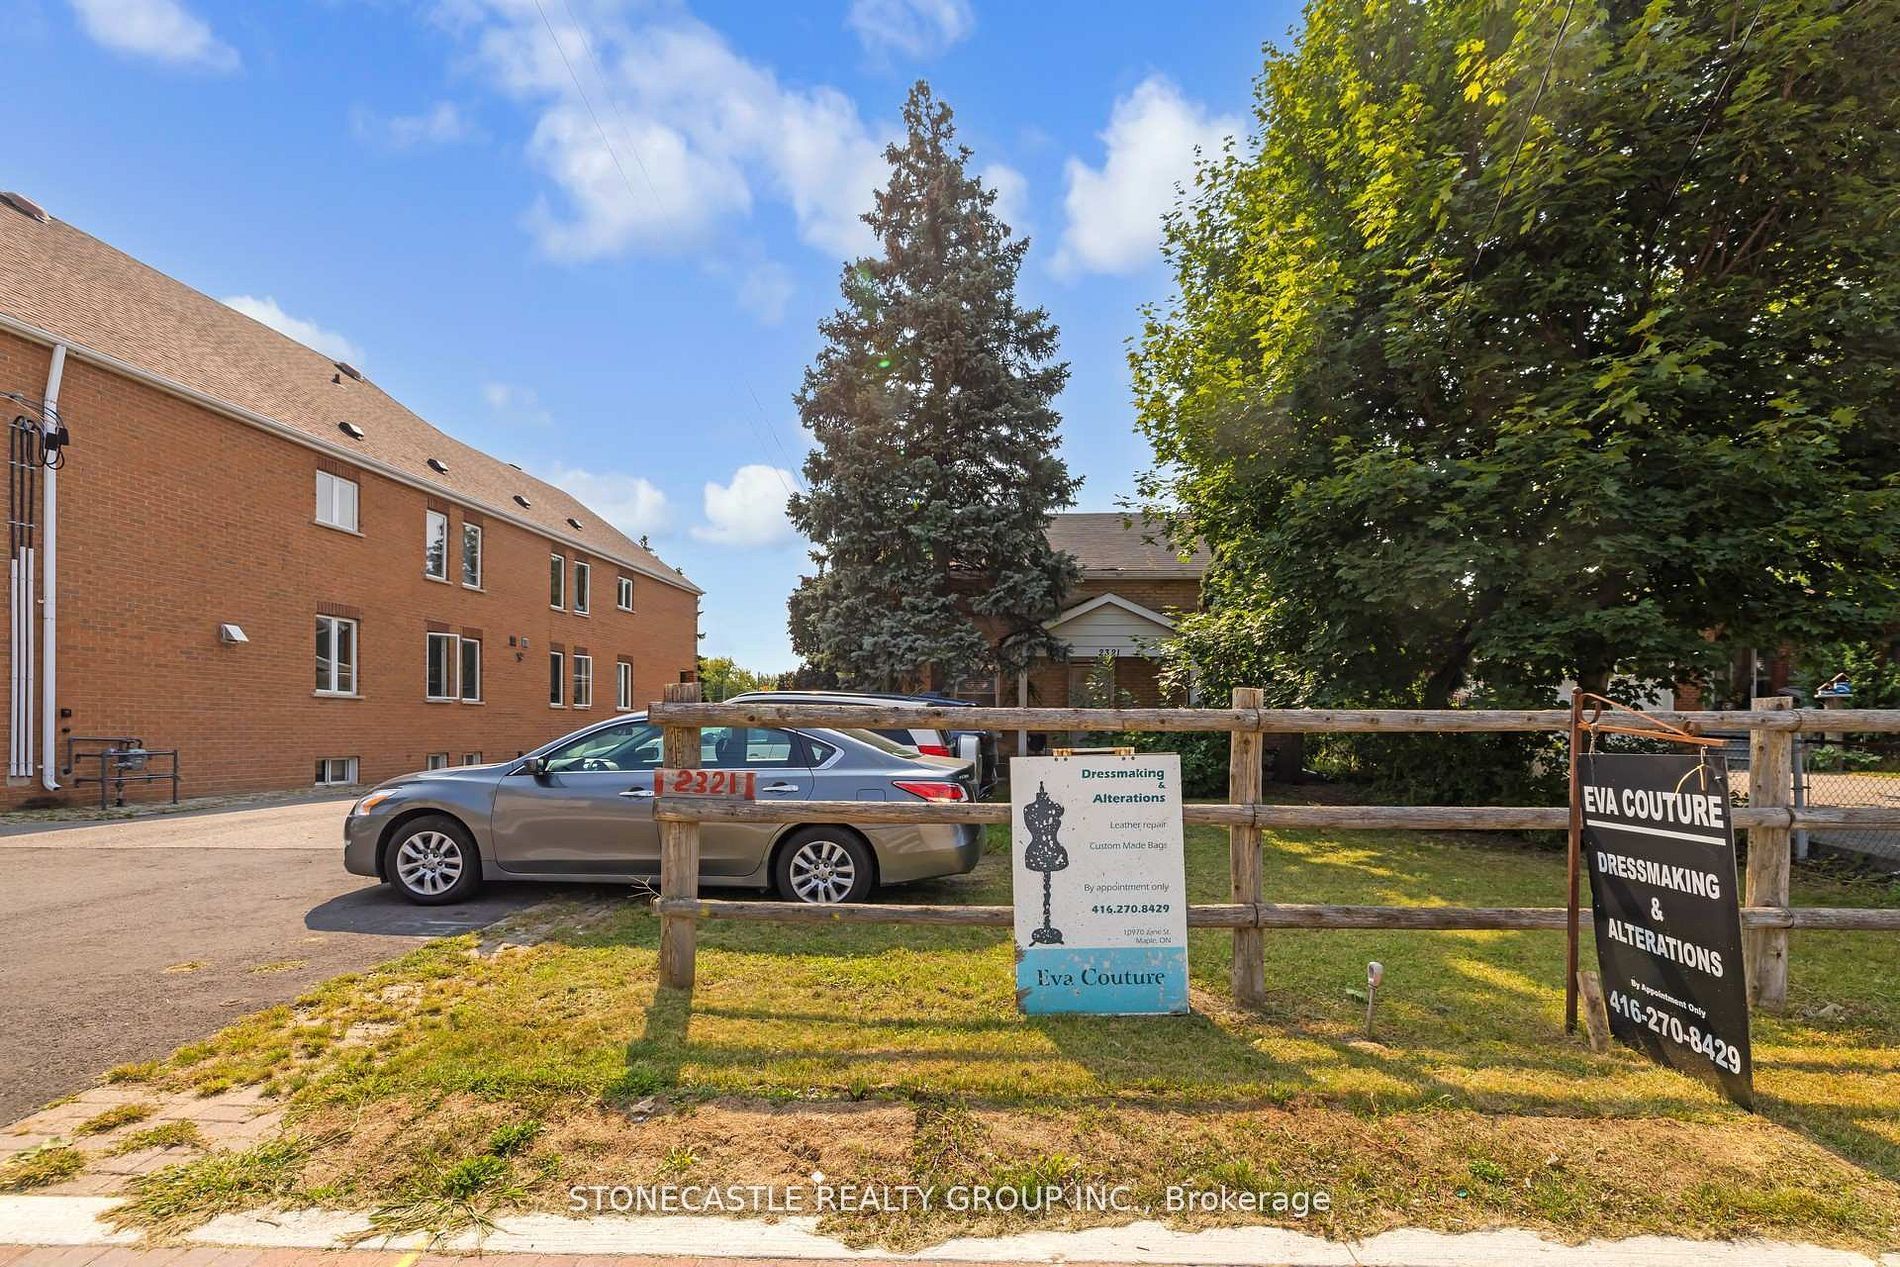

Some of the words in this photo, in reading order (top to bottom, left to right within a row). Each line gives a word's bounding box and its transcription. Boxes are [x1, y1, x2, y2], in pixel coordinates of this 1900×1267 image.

[1098, 648, 1120, 656] 2321
[673, 770, 736, 794] 2321
[1081, 768, 1165, 780] Dressmaking
[1092, 792, 1166, 804] Alterations
[1583, 785, 1620, 816] EVA
[1622, 788, 1725, 829] COUTURE
[1110, 821, 1141, 830] Leather
[1143, 821, 1167, 831] repair
[1089, 842, 1120, 850] Custom
[1122, 842, 1146, 850] Made
[1147, 841, 1168, 851] Bags
[1597, 851, 1721, 900] DRESSMAKING
[1084, 883, 1095, 894] By
[1096, 882, 1149, 893] appointment
[1151, 882, 1170, 893] only
[1091, 904, 1171, 915] 416.270.8429
[1651, 897, 1664, 922] &
[1608, 918, 1724, 978] ALTERATIONS
[1037, 968, 1075, 987] Eva
[1081, 967, 1166, 986] Couture
[1630, 978, 1641, 991] By
[1641, 983, 1688, 1009] Appointment
[1688, 1004, 1708, 1020] Only
[1608, 989, 1742, 1075] 416-270-8429
